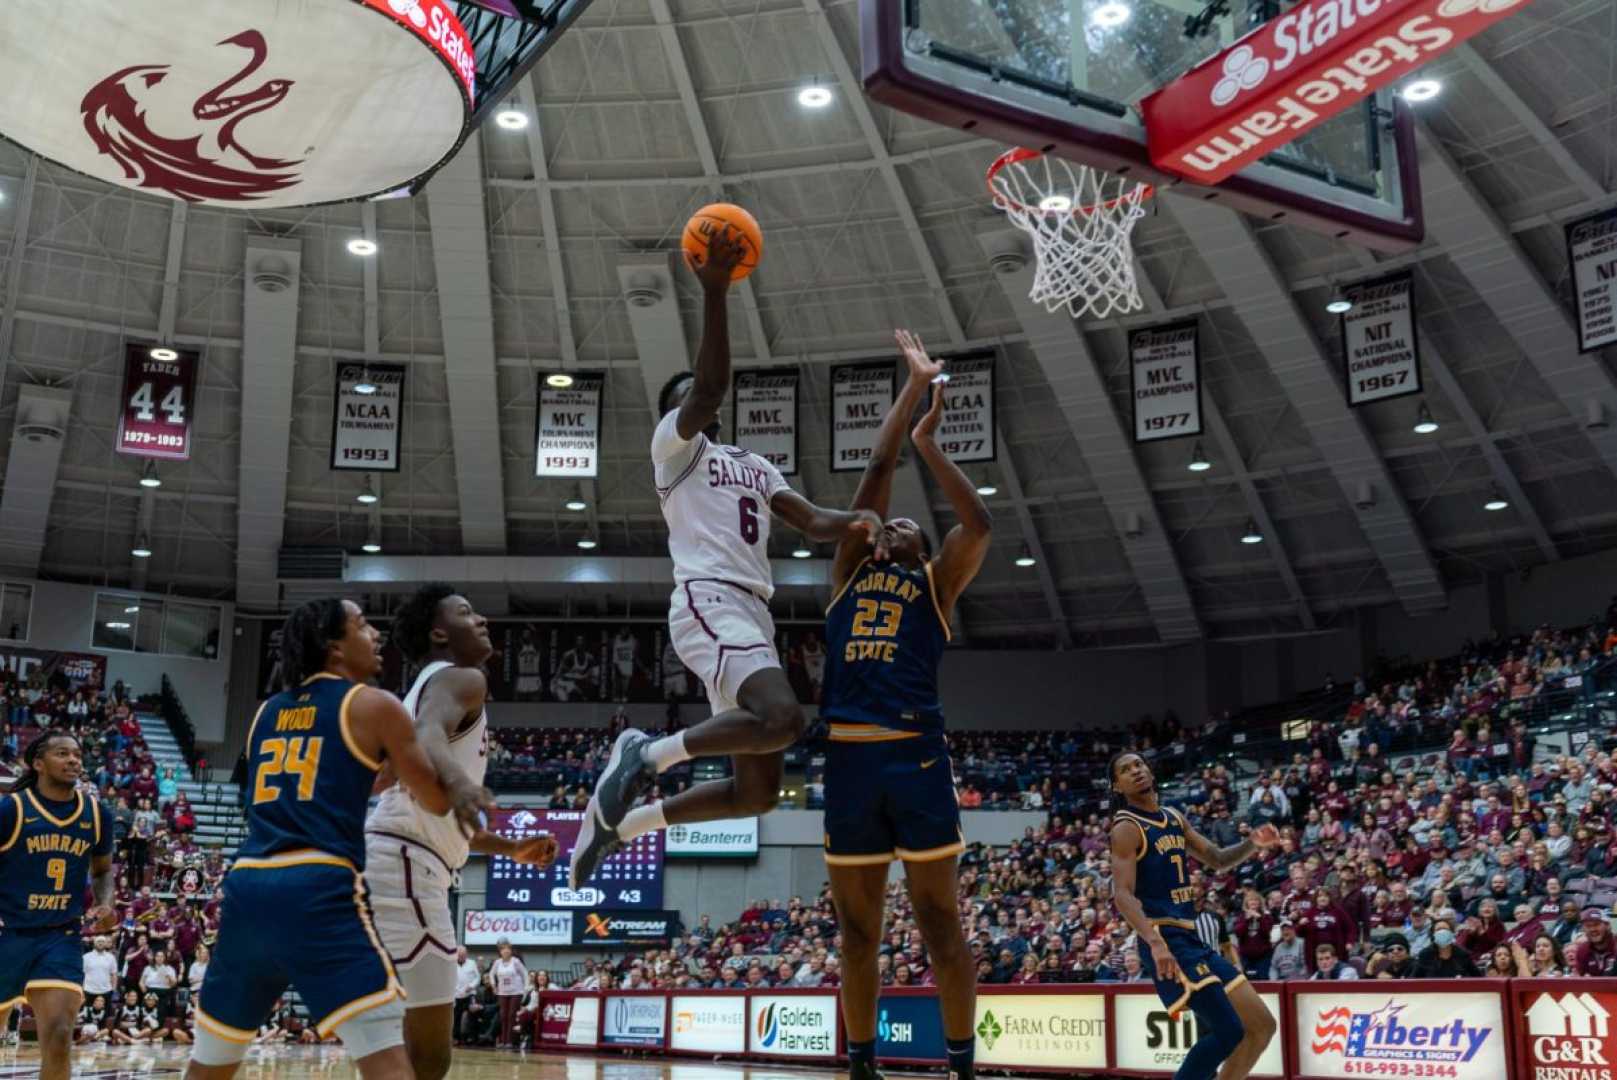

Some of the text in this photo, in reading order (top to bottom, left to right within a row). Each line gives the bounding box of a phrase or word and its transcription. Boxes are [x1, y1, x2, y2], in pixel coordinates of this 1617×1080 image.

[1365, 321, 1393, 342] NIT
[1354, 338, 1406, 358] NATIONAL
[1352, 350, 1412, 373] CHAMPIONS
[1147, 366, 1182, 385] MVC
[1359, 370, 1409, 393] 1967
[1137, 382, 1194, 399] CHAMPIONS
[130, 382, 185, 424] 44
[345, 403, 391, 420] NCAA
[846, 402, 881, 419] MVC
[552, 412, 586, 427] MVC
[749, 409, 783, 424] MVC
[945, 411, 979, 424] SWEET
[1144, 413, 1191, 431] 1977
[341, 421, 395, 431] TOURNAMENT
[542, 429, 595, 438] TOURNAMENT
[738, 426, 793, 437] CHAMPIONS
[940, 422, 984, 436] SIXTEEN
[540, 440, 596, 450] CHAMPIONS
[343, 448, 390, 461] 1993
[545, 456, 590, 468] 1993
[839, 448, 873, 462] 199
[738, 495, 759, 546] 6
[851, 598, 903, 637] 23
[844, 639, 898, 663] STATE
[275, 705, 317, 732] WOOD
[252, 736, 325, 806] 24
[546, 812, 580, 821] PLAYER
[26, 833, 91, 857] MURRAY
[689, 831, 753, 844] Banterra
[46, 857, 67, 892] 9
[27, 893, 72, 911] STATE
[507, 889, 531, 903] 40
[557, 891, 594, 902] 15:38
[618, 889, 641, 903] 43
[466, 911, 570, 933] Coors LIGHT
[608, 920, 667, 930] XTREAM
[554, 1004, 571, 1018] SIU
[779, 1007, 823, 1027] Golden
[891, 1023, 912, 1042] SIH
[1004, 1015, 1105, 1037] FARM CREDIT
[779, 1031, 830, 1051] Harvest
[1018, 1038, 1091, 1051] ILLINOIS
[1344, 1013, 1492, 1063] Liberty
[1364, 1049, 1457, 1061] GRAPHICS & SIGNS
[1534, 1036, 1610, 1065] G&R
[1344, 1061, 1458, 1077] 618-993-3344
[1535, 1066, 1612, 1080] RENTALS
